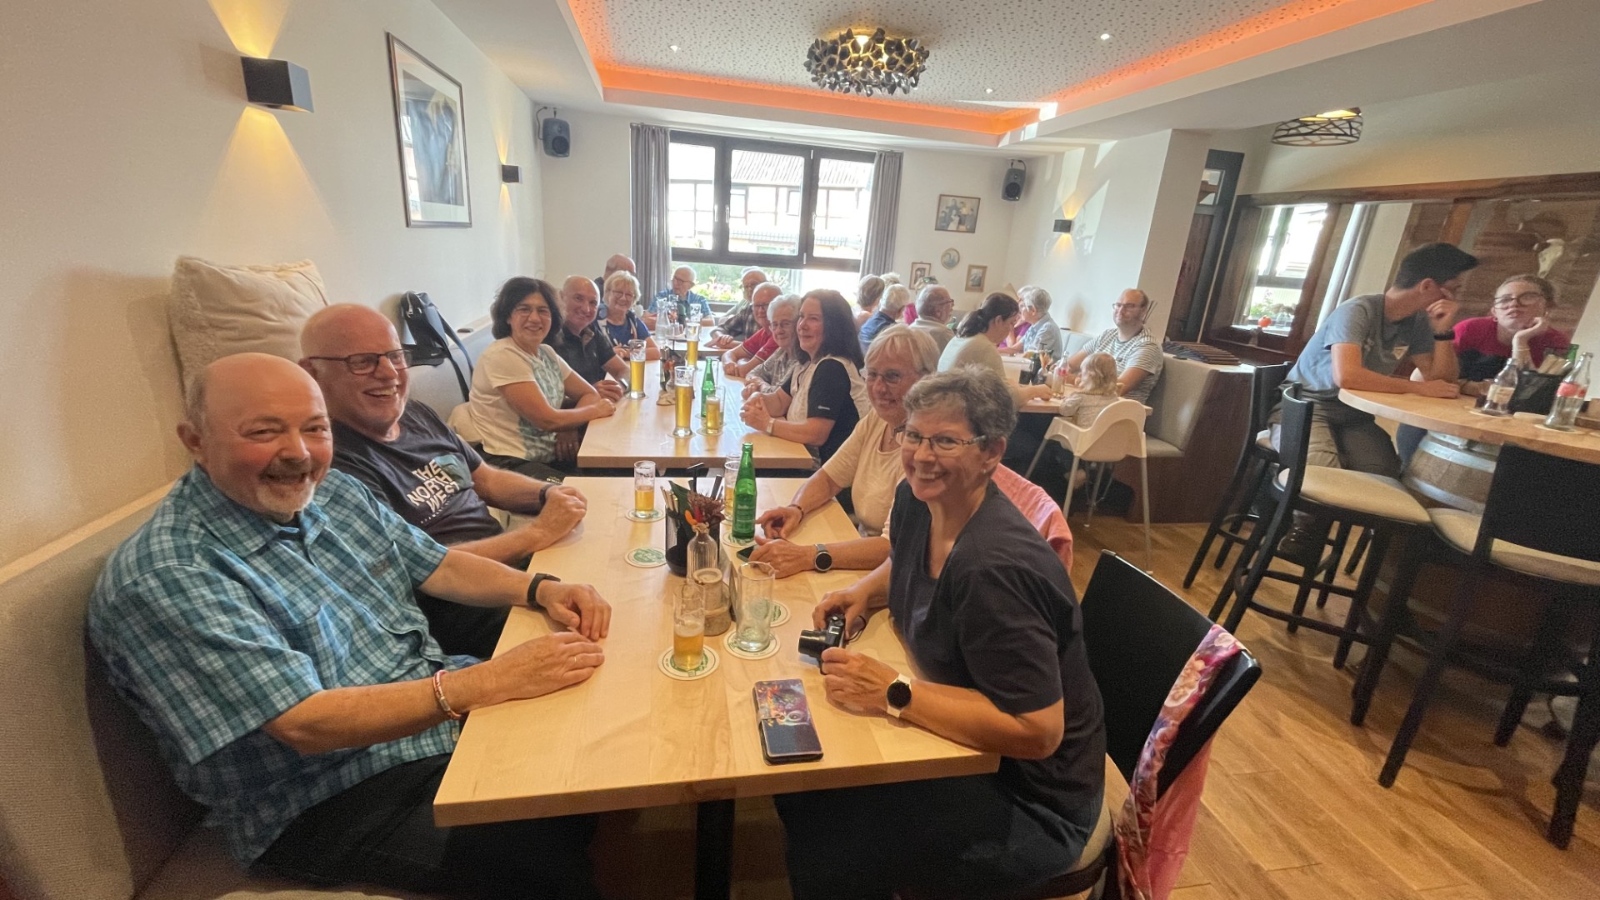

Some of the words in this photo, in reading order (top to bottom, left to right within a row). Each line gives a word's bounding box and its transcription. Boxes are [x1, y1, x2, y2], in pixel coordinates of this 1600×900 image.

[411, 459, 441, 481] THE
[407, 470, 453, 506] NORTH
[426, 481, 460, 513] WEST
